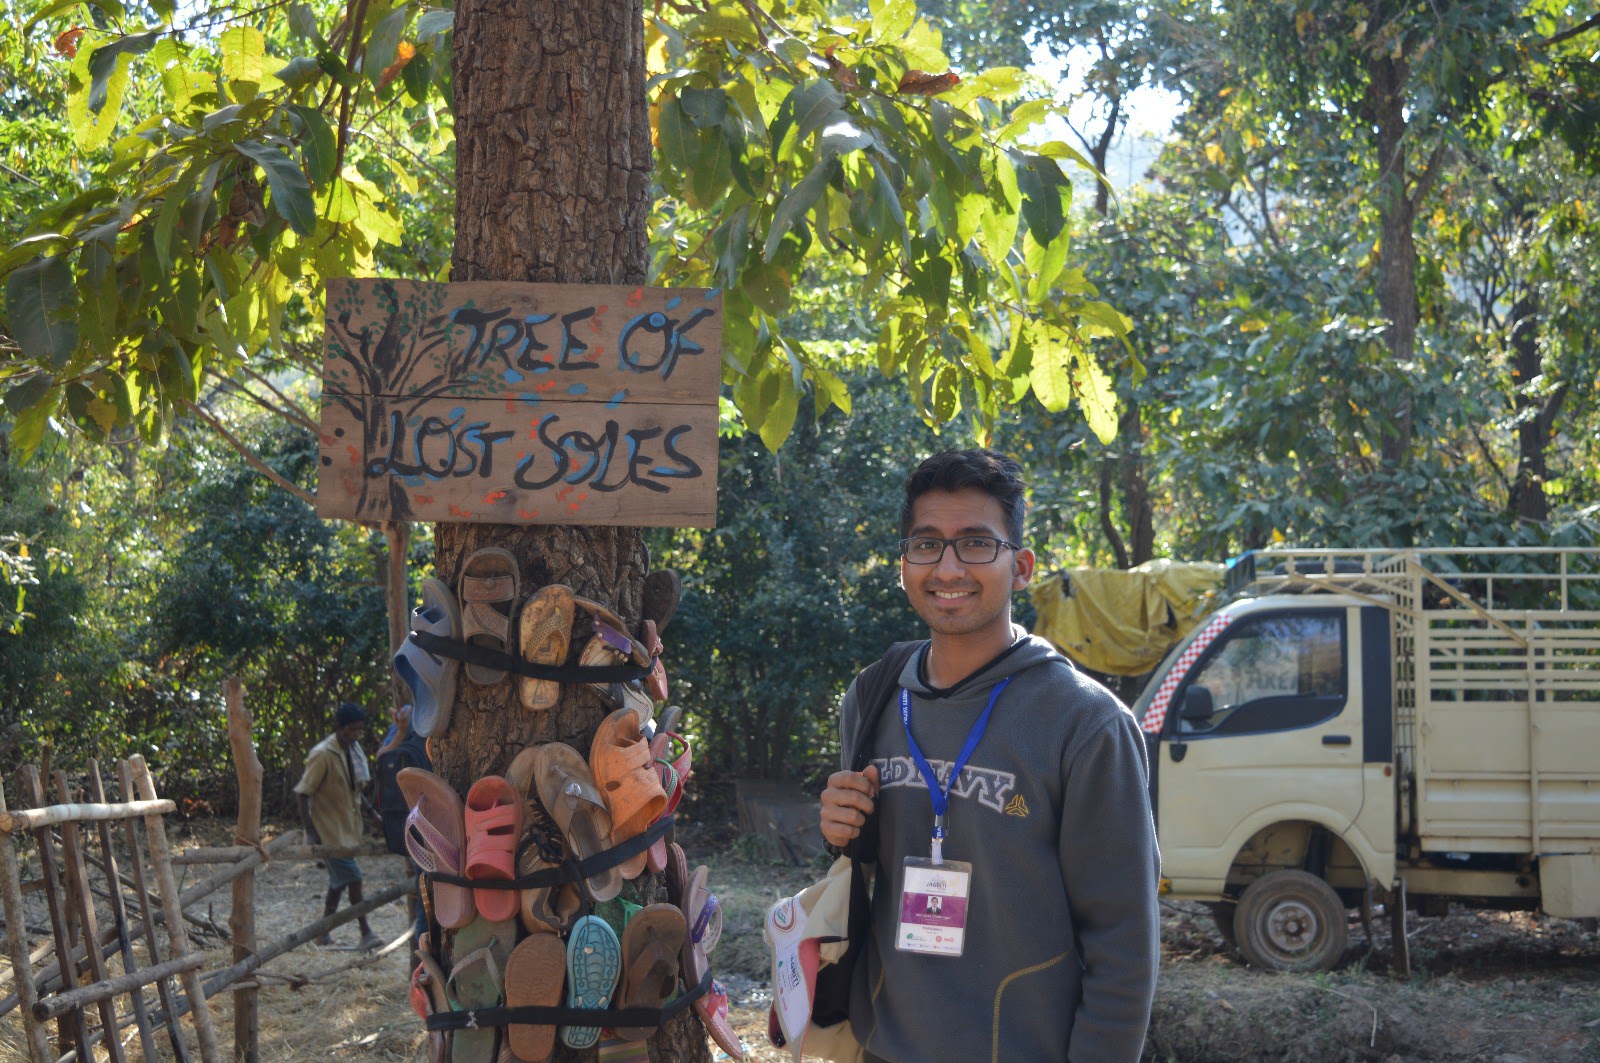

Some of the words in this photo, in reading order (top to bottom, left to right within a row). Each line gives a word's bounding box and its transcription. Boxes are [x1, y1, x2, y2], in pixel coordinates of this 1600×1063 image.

[451, 307, 599, 372] TREE
[620, 308, 715, 381] OF
[366, 409, 515, 480] LOST
[514, 414, 702, 494] SOLES
